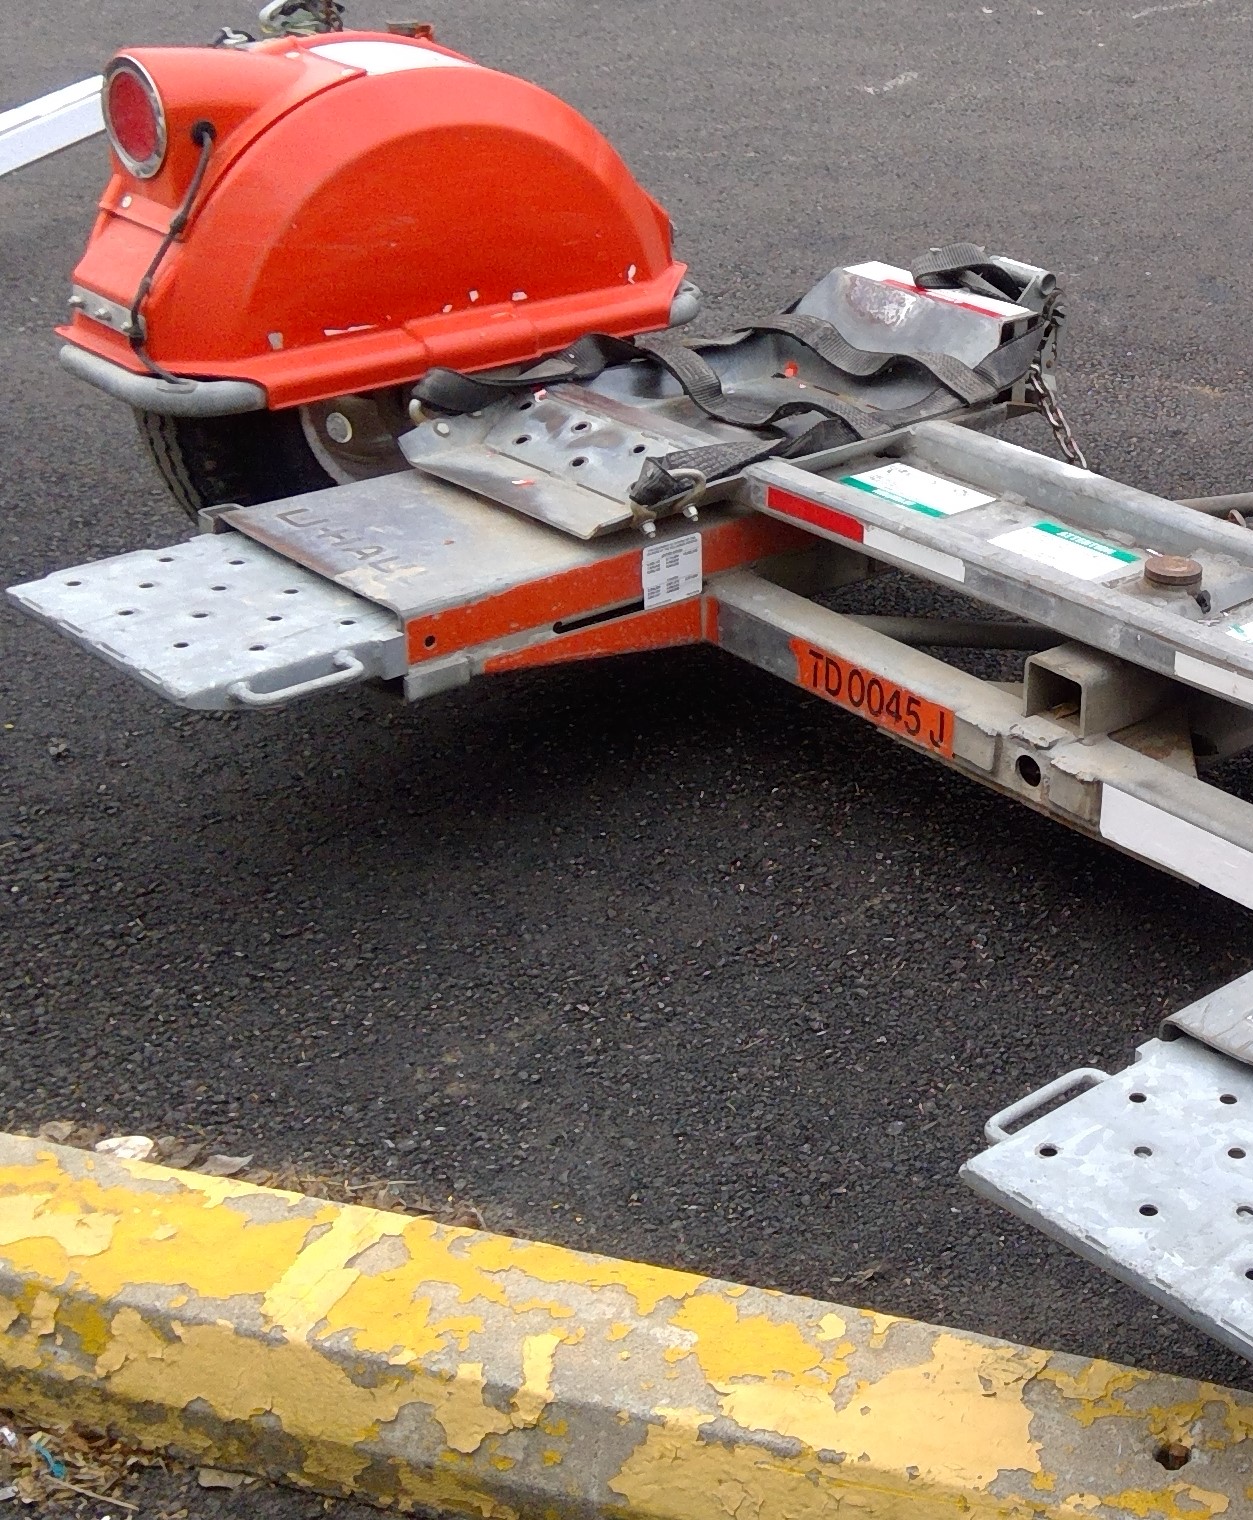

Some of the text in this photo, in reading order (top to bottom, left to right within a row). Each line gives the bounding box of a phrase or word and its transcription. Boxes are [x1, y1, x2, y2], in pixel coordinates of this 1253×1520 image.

[809, 649, 944, 748] TD 0045 J
